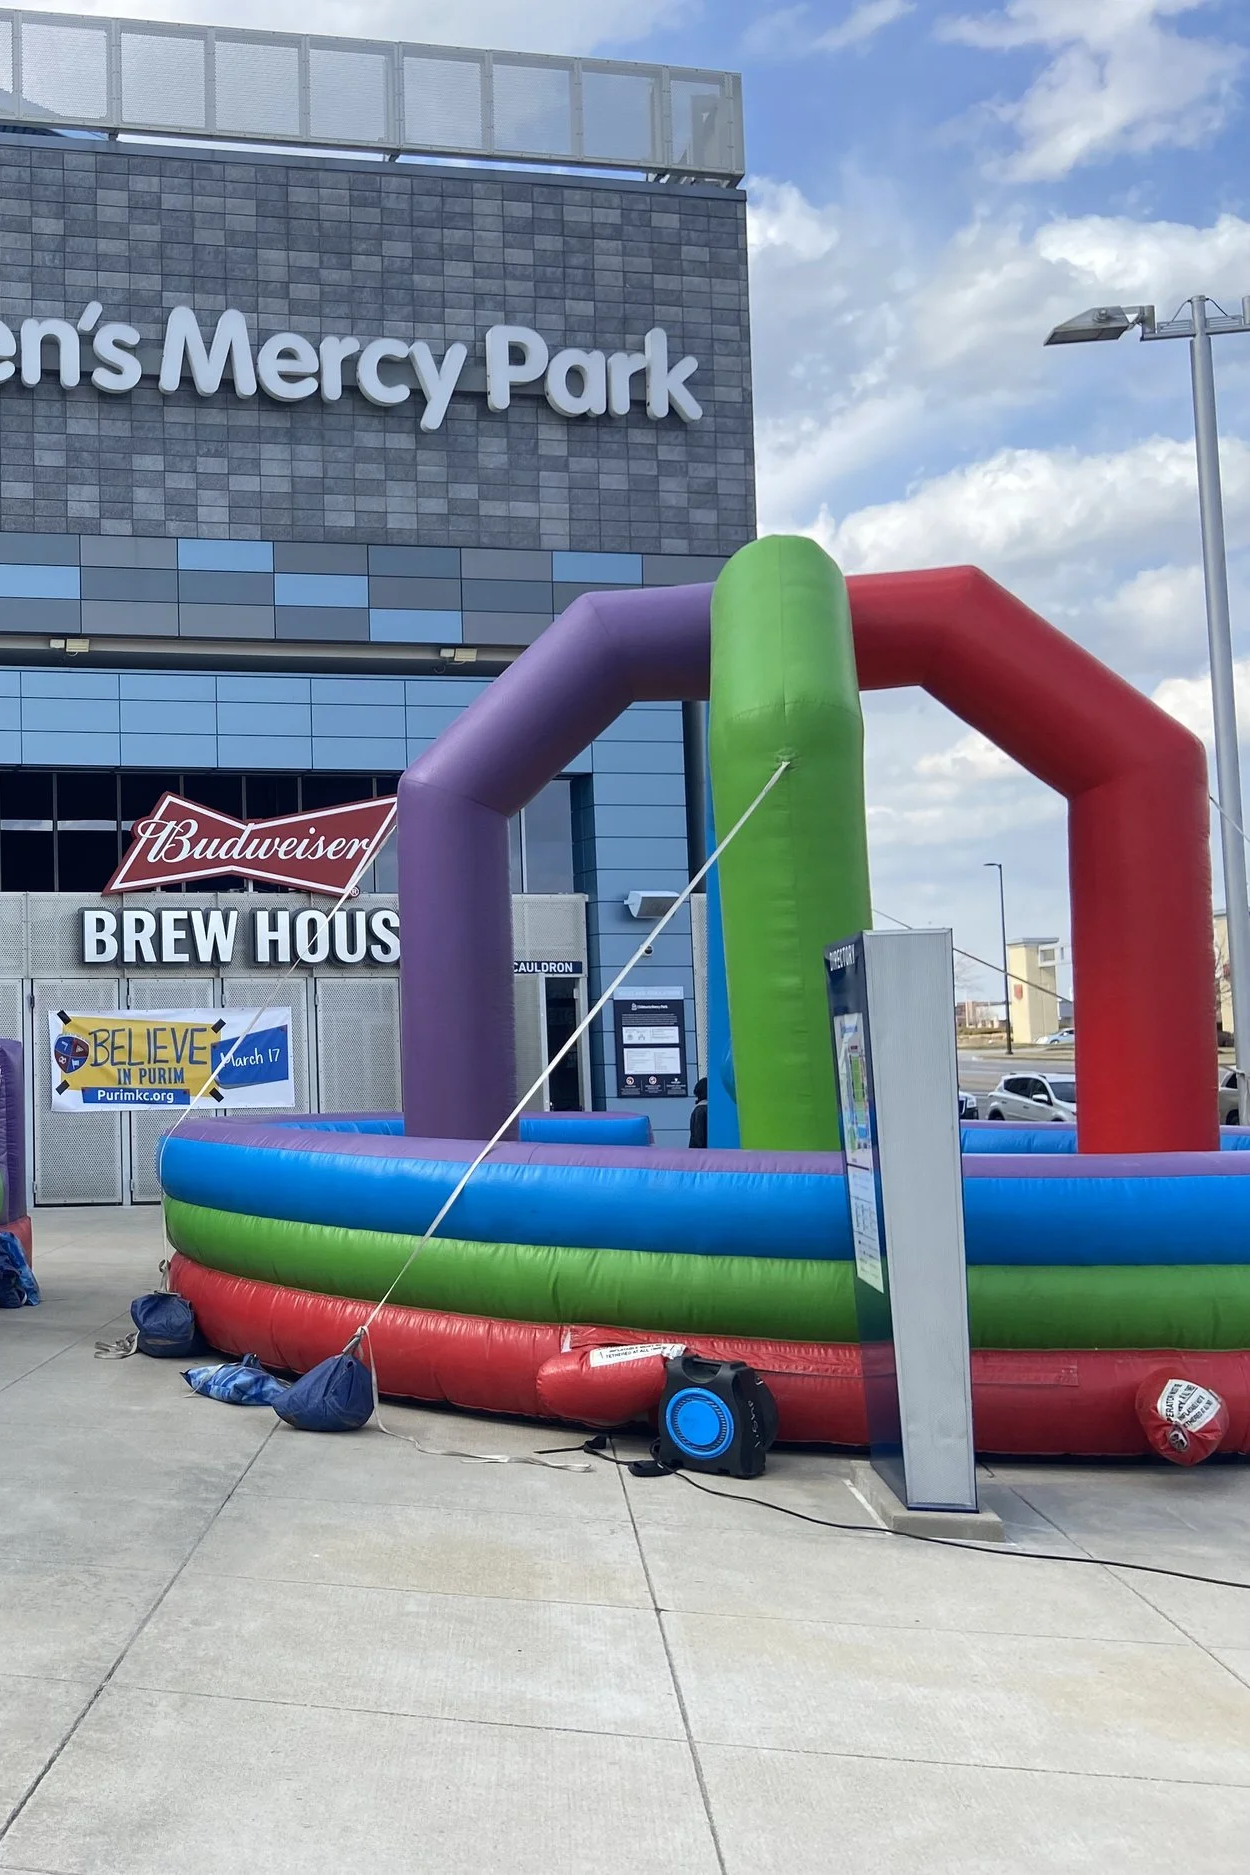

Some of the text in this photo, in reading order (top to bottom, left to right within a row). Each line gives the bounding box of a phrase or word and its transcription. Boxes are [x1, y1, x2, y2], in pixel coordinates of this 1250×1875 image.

[158, 305, 468, 432] Mercy
[485, 323, 704, 424] Park
[137, 818, 374, 863] Budweiser
[83, 908, 400, 964] BREW HOUS
[829, 943, 855, 972] DIRECTORY
[88, 1027, 208, 1067] BELIEVE
[268, 1048, 280, 1063] 17
[117, 1066, 185, 1086] IN PURIM
[97, 1088, 175, 1104] Purimkc.org
